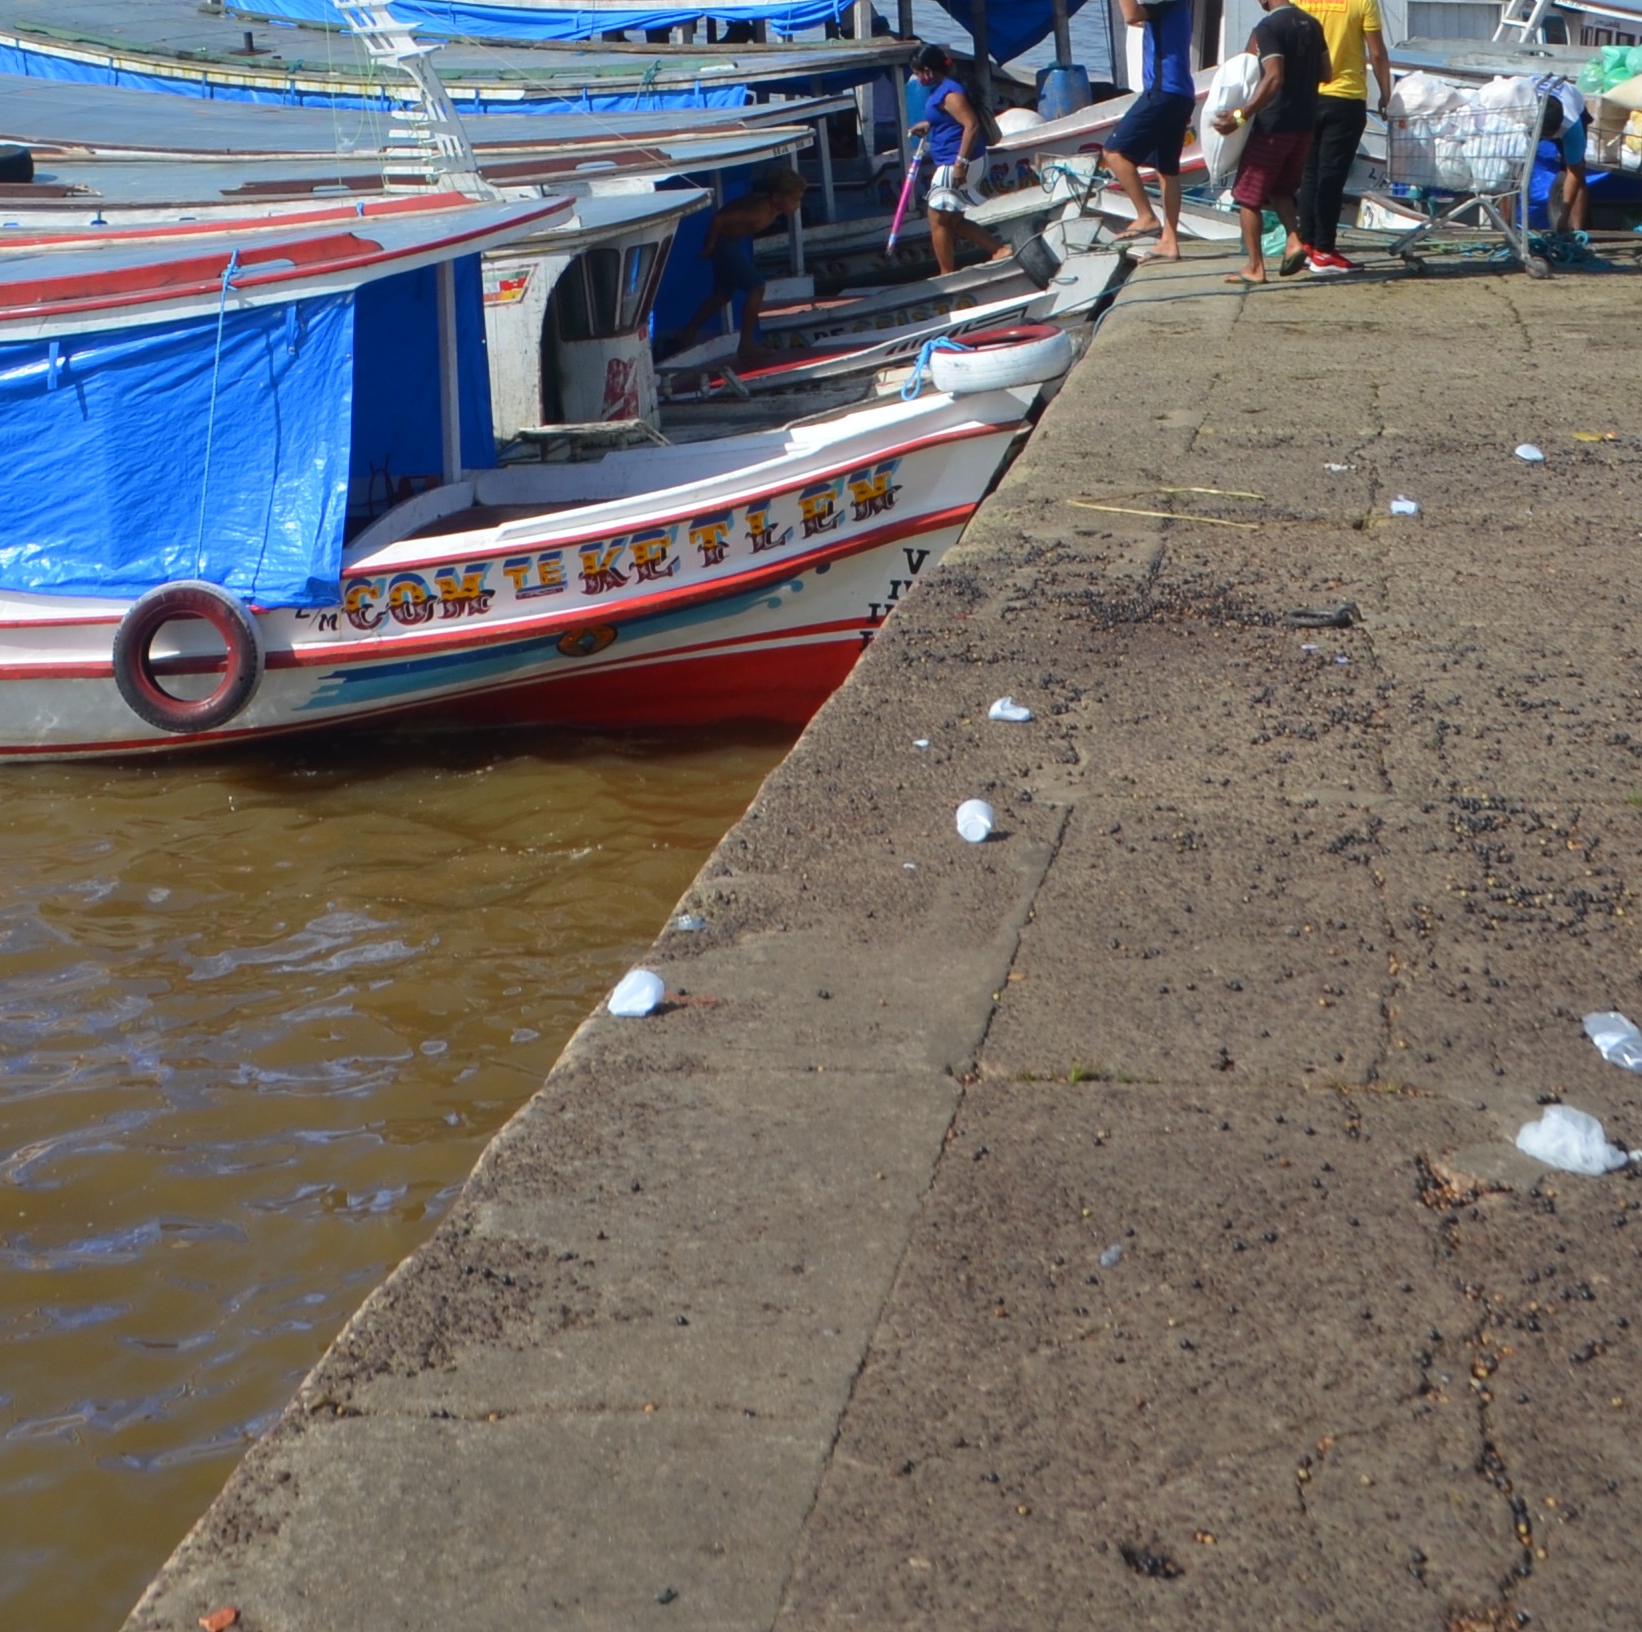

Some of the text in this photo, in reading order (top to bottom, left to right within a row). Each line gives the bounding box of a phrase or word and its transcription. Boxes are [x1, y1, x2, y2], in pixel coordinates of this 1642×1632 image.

[342, 561, 496, 631] COM
[576, 457, 903, 596] KETLEN
[903, 548, 930, 575] V
